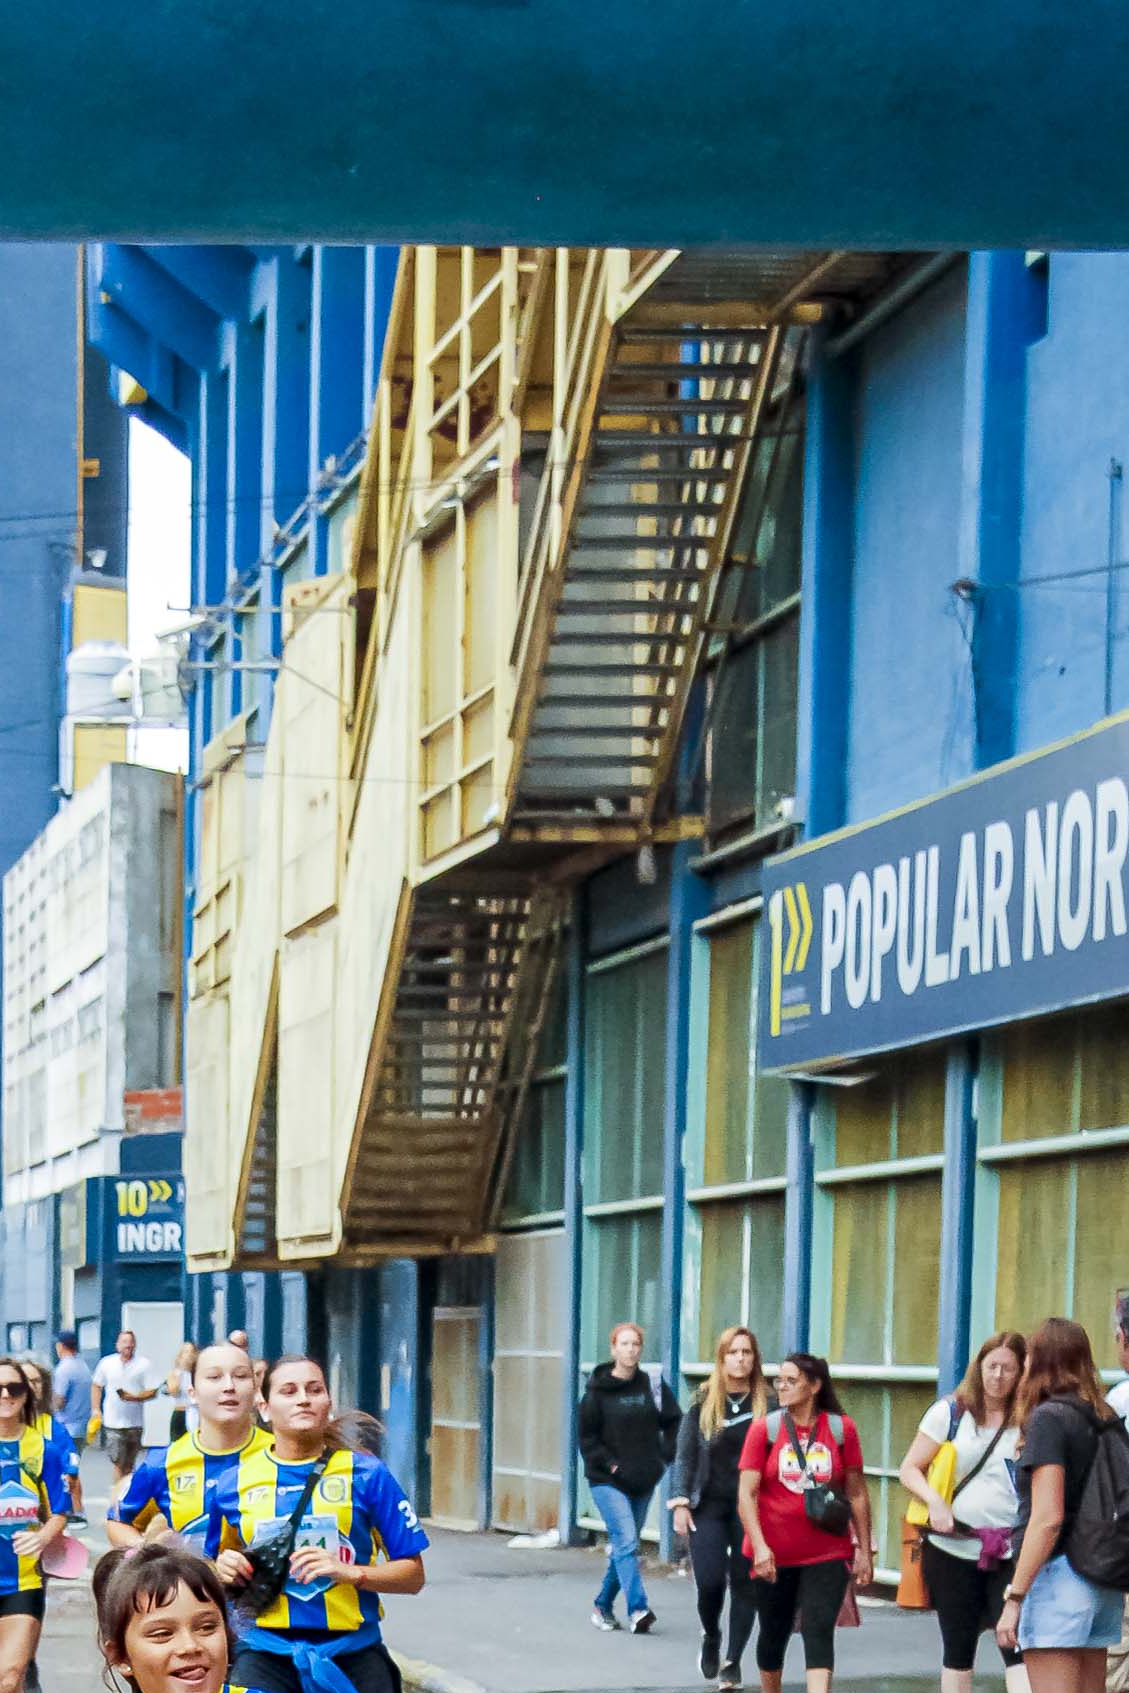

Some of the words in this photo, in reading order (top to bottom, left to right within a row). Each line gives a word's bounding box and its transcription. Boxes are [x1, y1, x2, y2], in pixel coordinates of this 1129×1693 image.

[820, 820, 1014, 1015] POPULAR
[1022, 776, 1129, 961] NOR
[115, 1181, 148, 1217] 10
[118, 1222, 182, 1253] INGR
